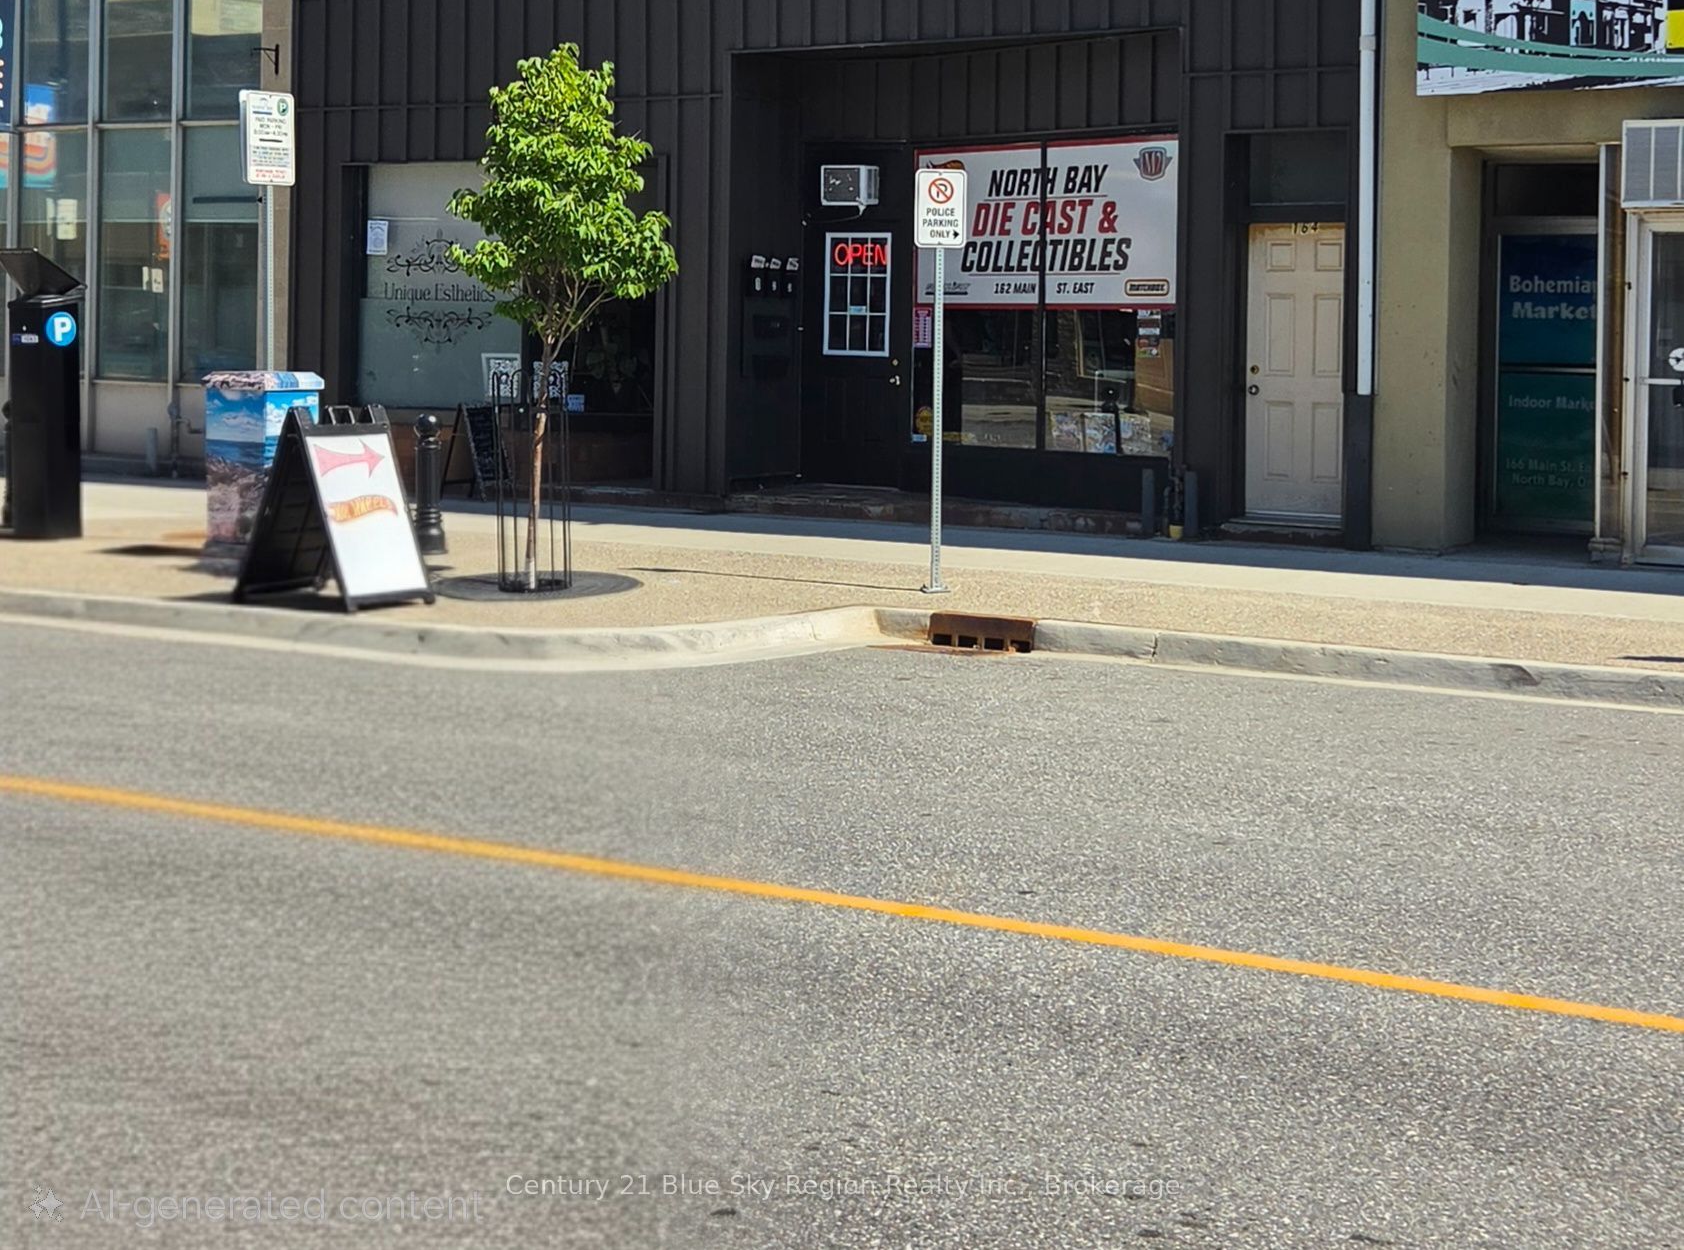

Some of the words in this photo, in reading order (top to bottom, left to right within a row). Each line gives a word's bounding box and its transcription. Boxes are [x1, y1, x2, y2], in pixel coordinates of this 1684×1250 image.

[988, 166, 1058, 197] NORTH
[1063, 164, 1108, 195] BAY
[926, 208, 955, 217] POLICE
[972, 201, 1016, 237] DIE
[1021, 199, 1094, 235] CAST
[1098, 201, 1119, 234] &
[922, 219, 959, 228] PARKING
[929, 230, 951, 238] ONLY
[834, 243, 888, 266] OPEN
[961, 237, 1132, 273] COLLECTIBLES
[384, 282, 431, 306] Unique
[1013, 282, 1037, 294] MAIN
[1056, 282, 1070, 294] ST.
[1072, 282, 1095, 294] EAST
[1508, 395, 1552, 409] Indoor
